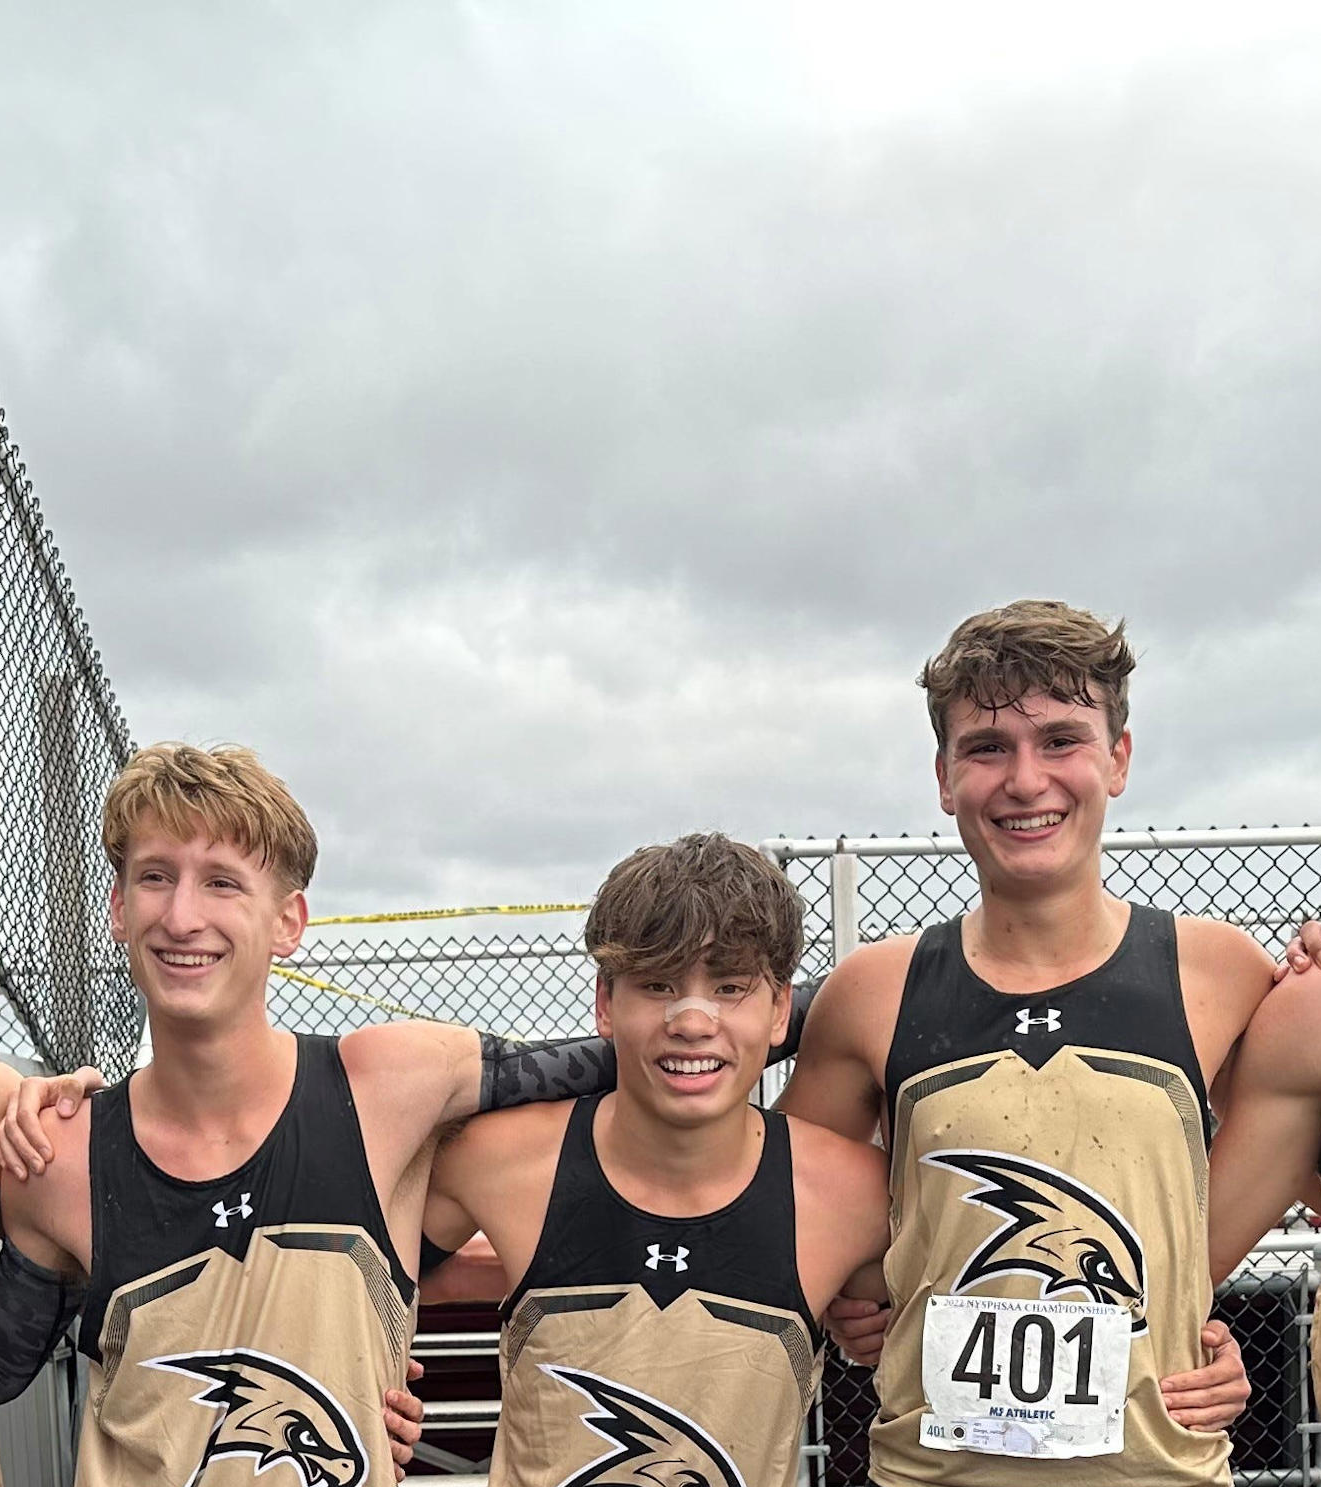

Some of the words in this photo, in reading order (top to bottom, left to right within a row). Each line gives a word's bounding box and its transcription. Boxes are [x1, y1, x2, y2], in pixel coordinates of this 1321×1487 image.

[966, 1300, 1022, 1312] NYSPHSAA
[1024, 1304, 1116, 1316] CHAMPIONSHIPS
[951, 1312, 1099, 1405] 401
[1006, 1409, 1055, 1420] ATHLETIC
[926, 1425, 946, 1438] 401
